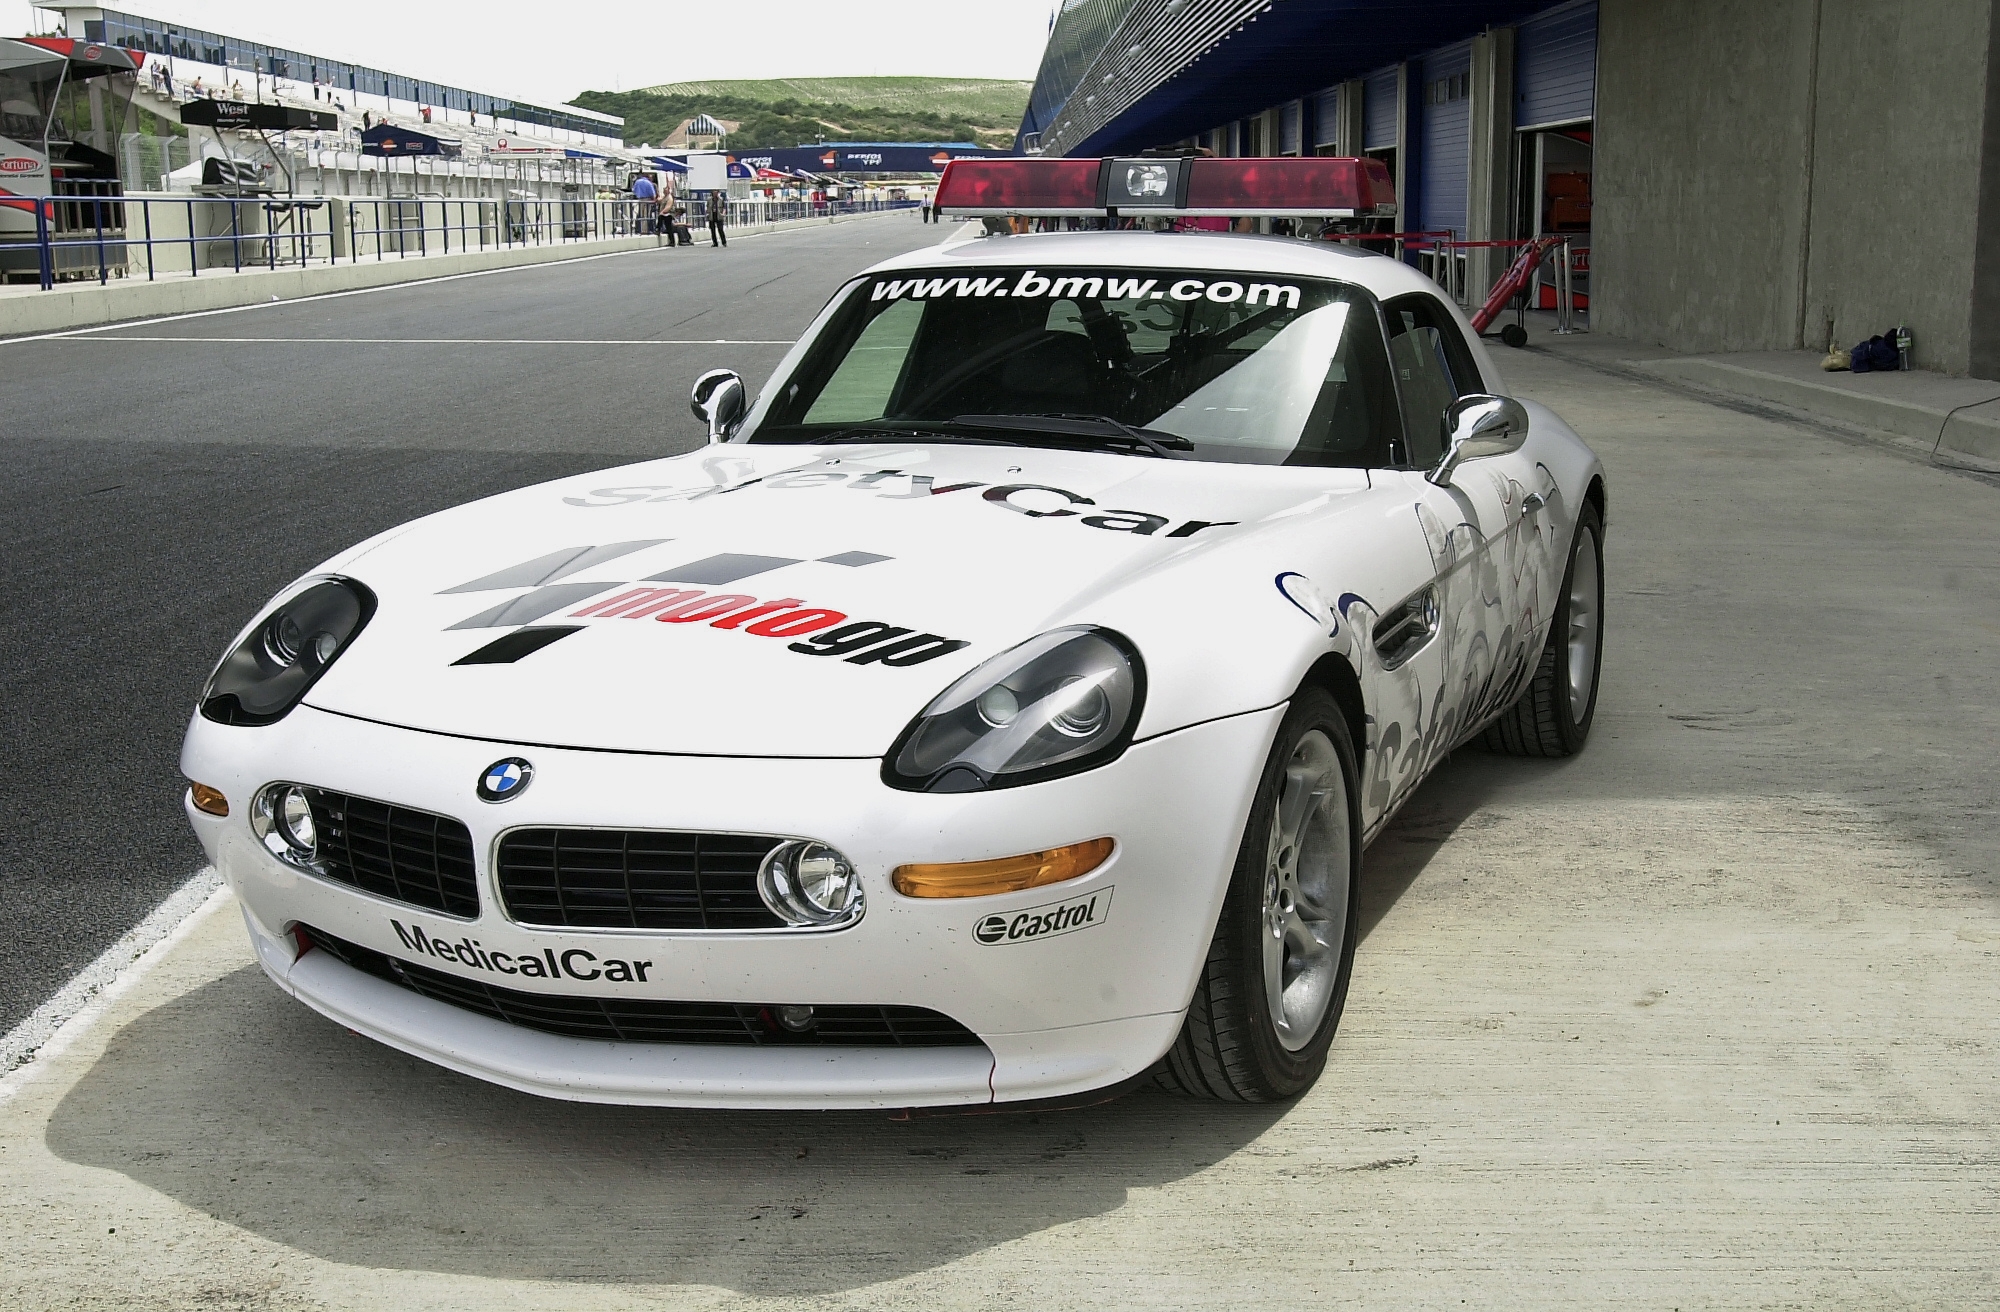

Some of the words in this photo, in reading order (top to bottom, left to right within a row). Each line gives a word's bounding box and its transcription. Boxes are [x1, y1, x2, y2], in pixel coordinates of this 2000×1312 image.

[216, 102, 250, 115] West
[871, 270, 1301, 310] www.bmw.com
[567, 587, 972, 667] motogp
[1007, 895, 1097, 940] Castrol
[389, 918, 653, 983] MedicalCar
